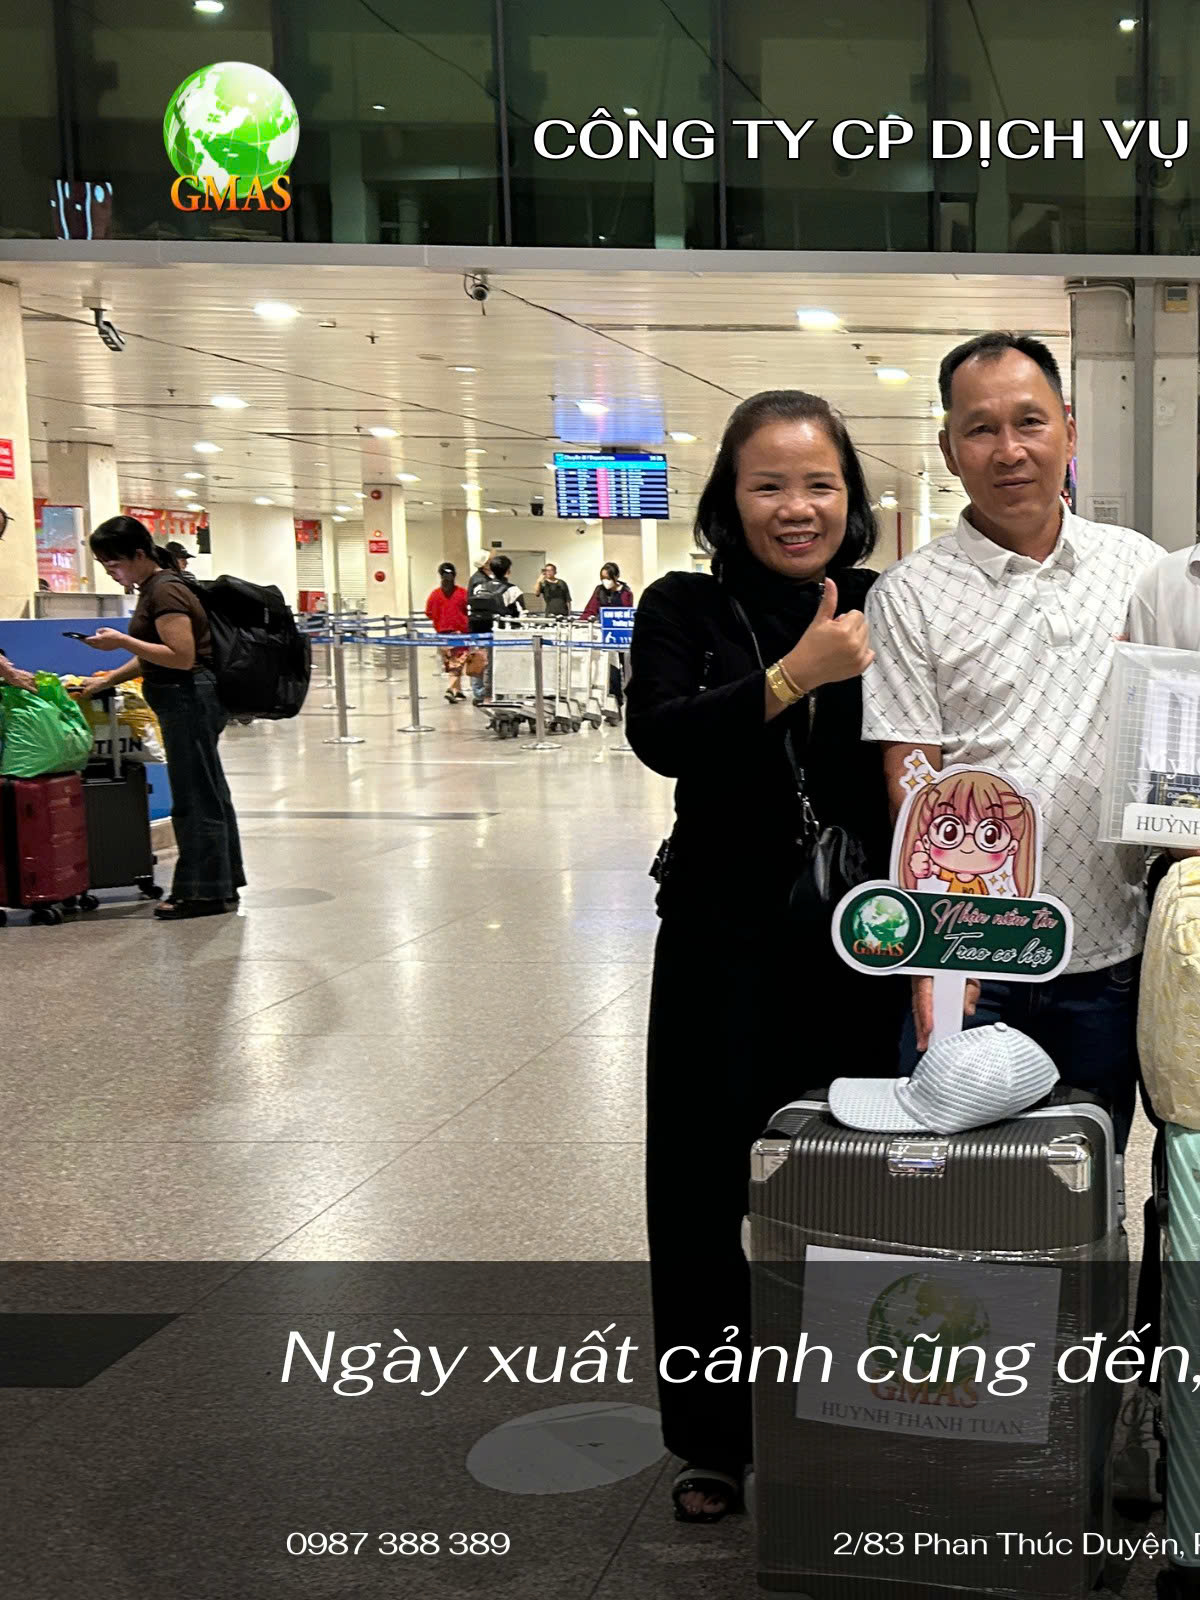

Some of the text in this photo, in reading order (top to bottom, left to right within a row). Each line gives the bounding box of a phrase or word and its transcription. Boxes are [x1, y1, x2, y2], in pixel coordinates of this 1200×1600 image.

[852, 939, 904, 957] GMAS
[940, 931, 991, 964] Trao
[893, 1407, 965, 1434] THANH
